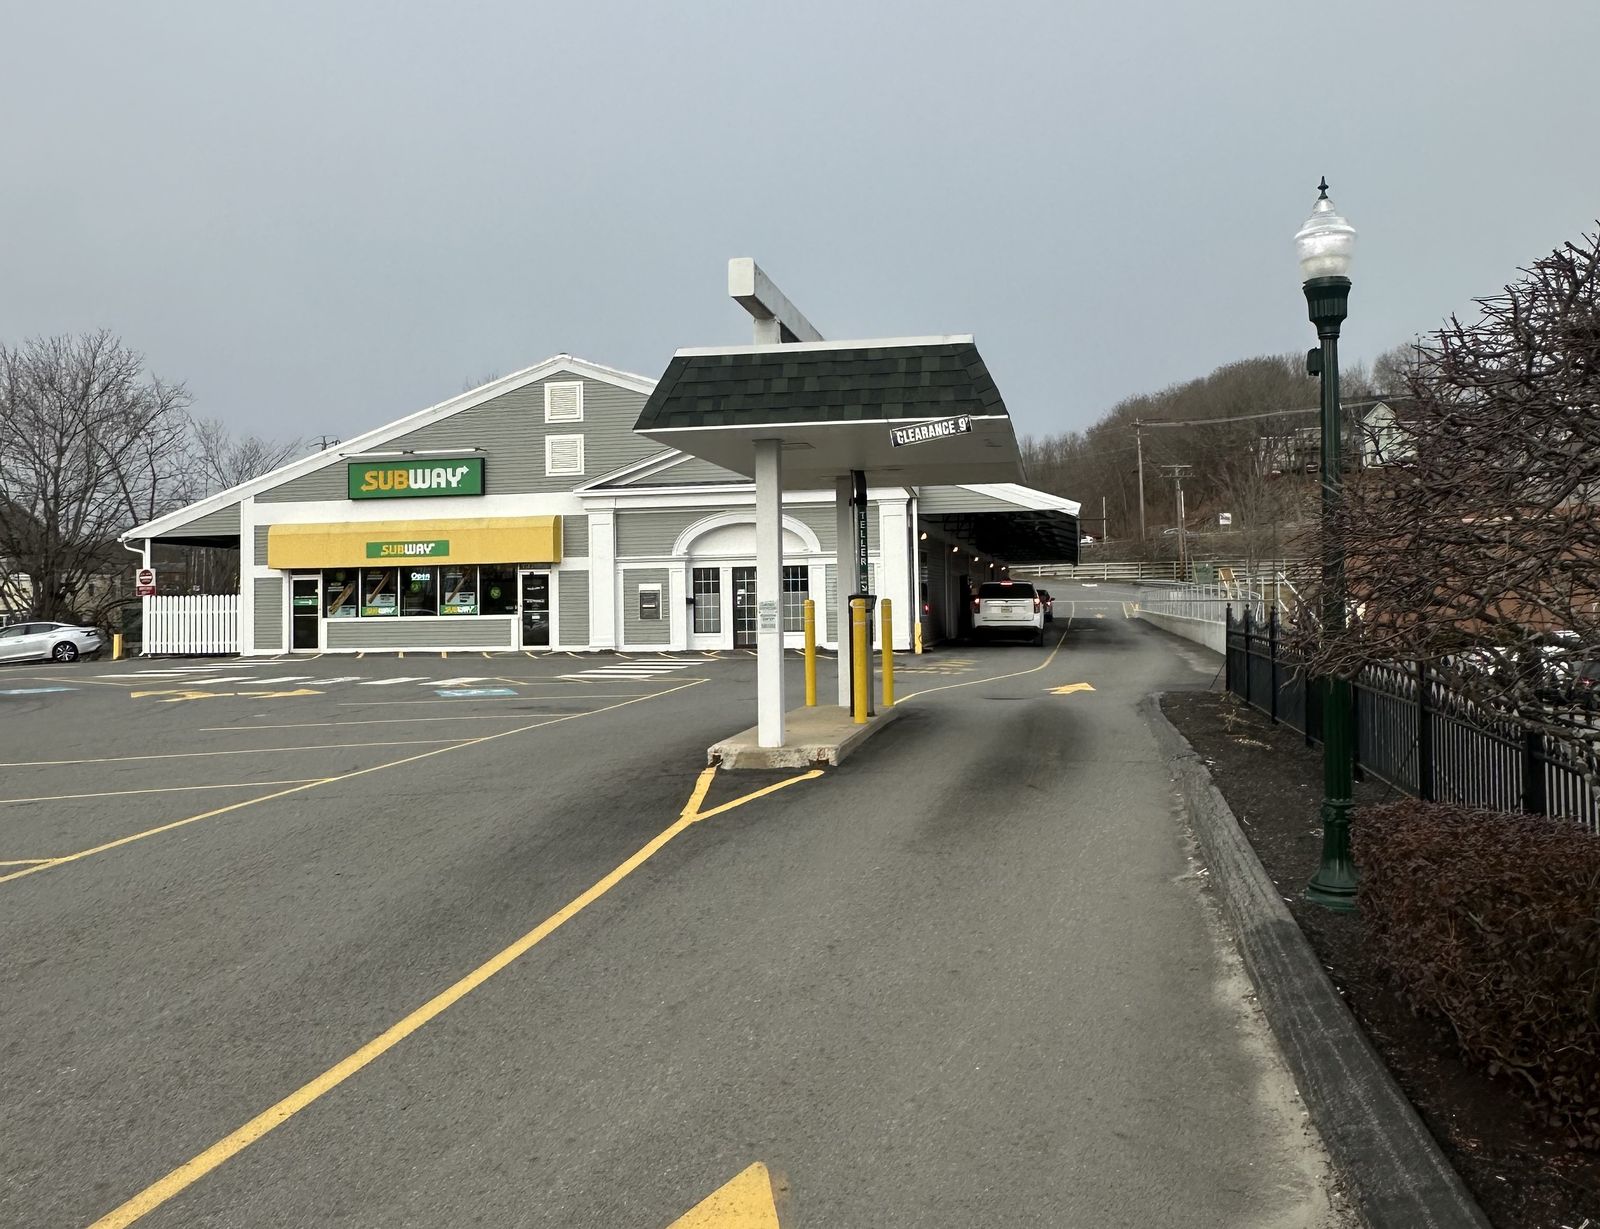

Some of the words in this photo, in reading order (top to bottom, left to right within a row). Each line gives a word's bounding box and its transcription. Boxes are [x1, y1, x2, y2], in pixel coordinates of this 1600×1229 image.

[896, 420, 956, 444] CLEARANCE
[361, 465, 469, 491] SUBWAY
[380, 543, 435, 556] SUBWAY
[859, 511, 867, 566] TELLER
